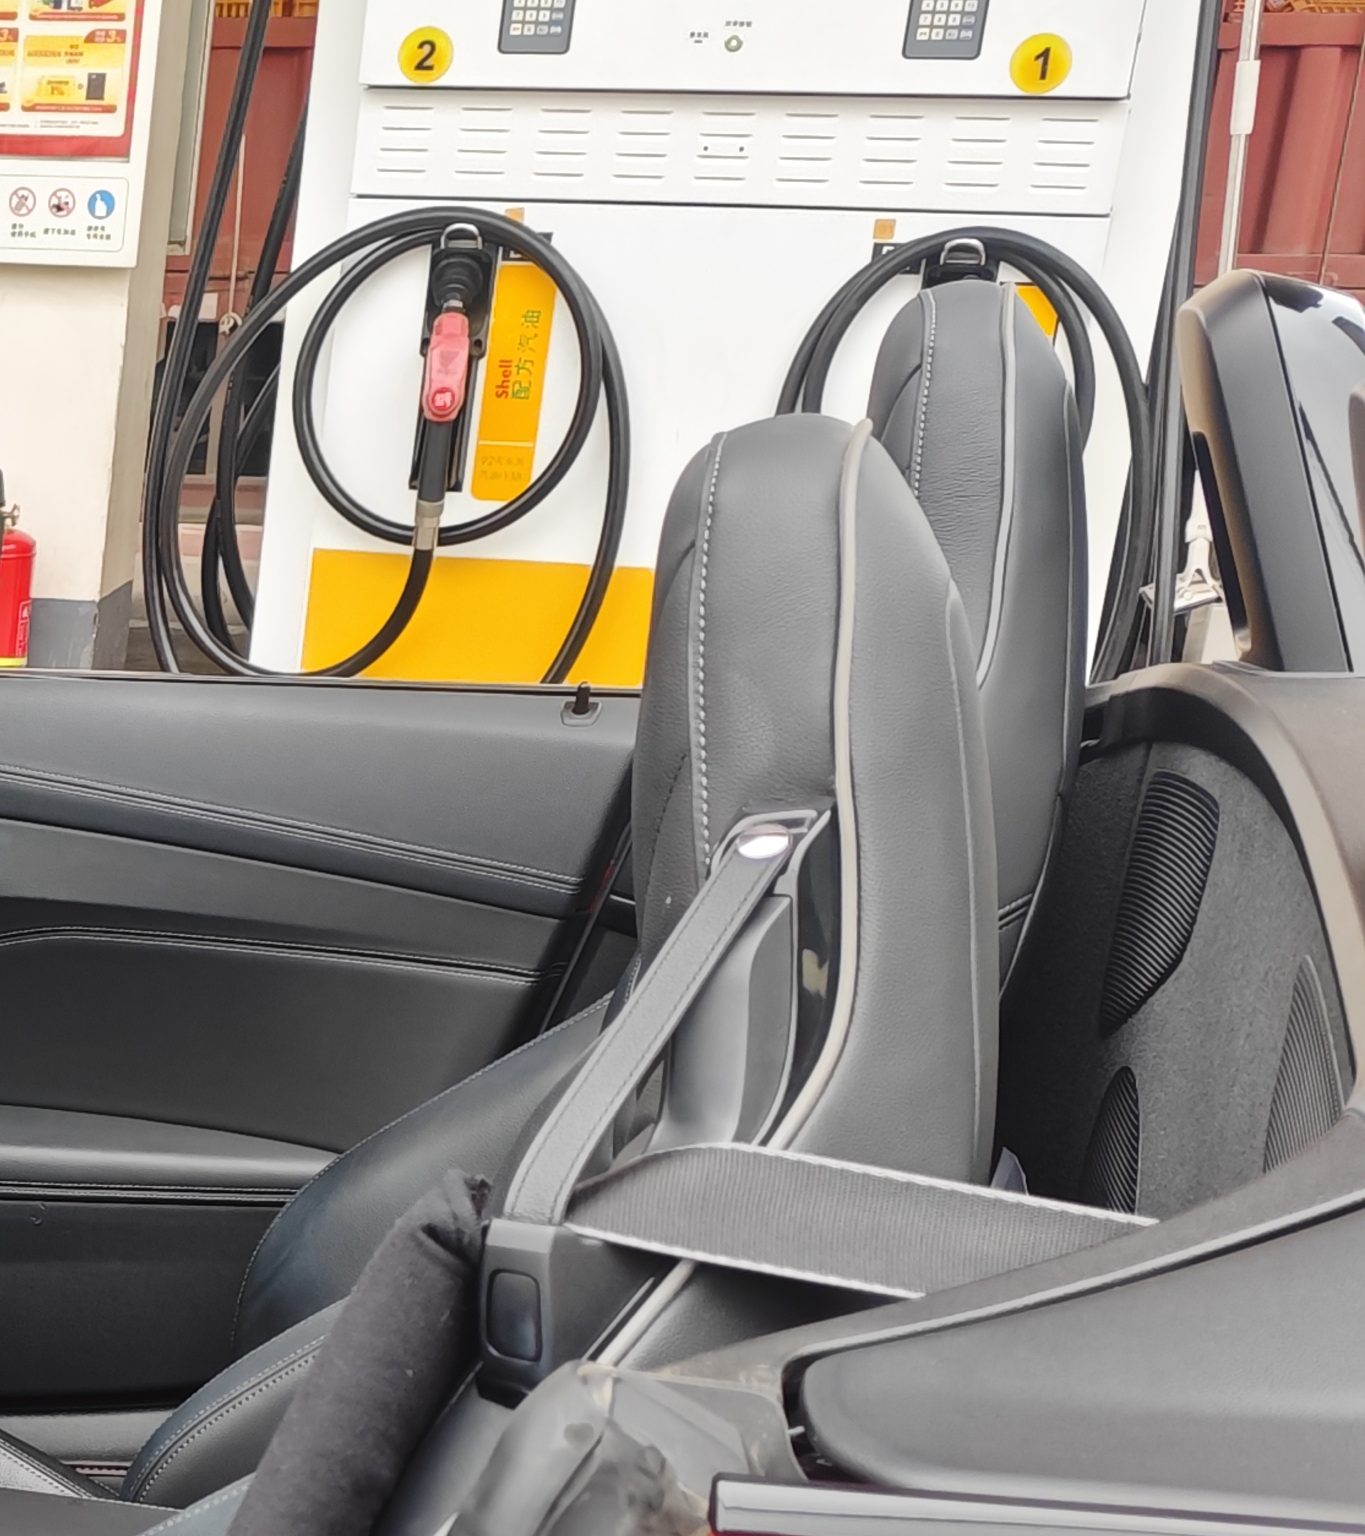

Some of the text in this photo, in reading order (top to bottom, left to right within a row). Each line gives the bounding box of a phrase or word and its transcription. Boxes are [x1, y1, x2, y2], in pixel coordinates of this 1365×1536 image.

[413, 40, 437, 71] 2
[1033, 47, 1052, 81] 1
[510, 309, 542, 400] 配方汽油
[495, 359, 513, 399] Shell
